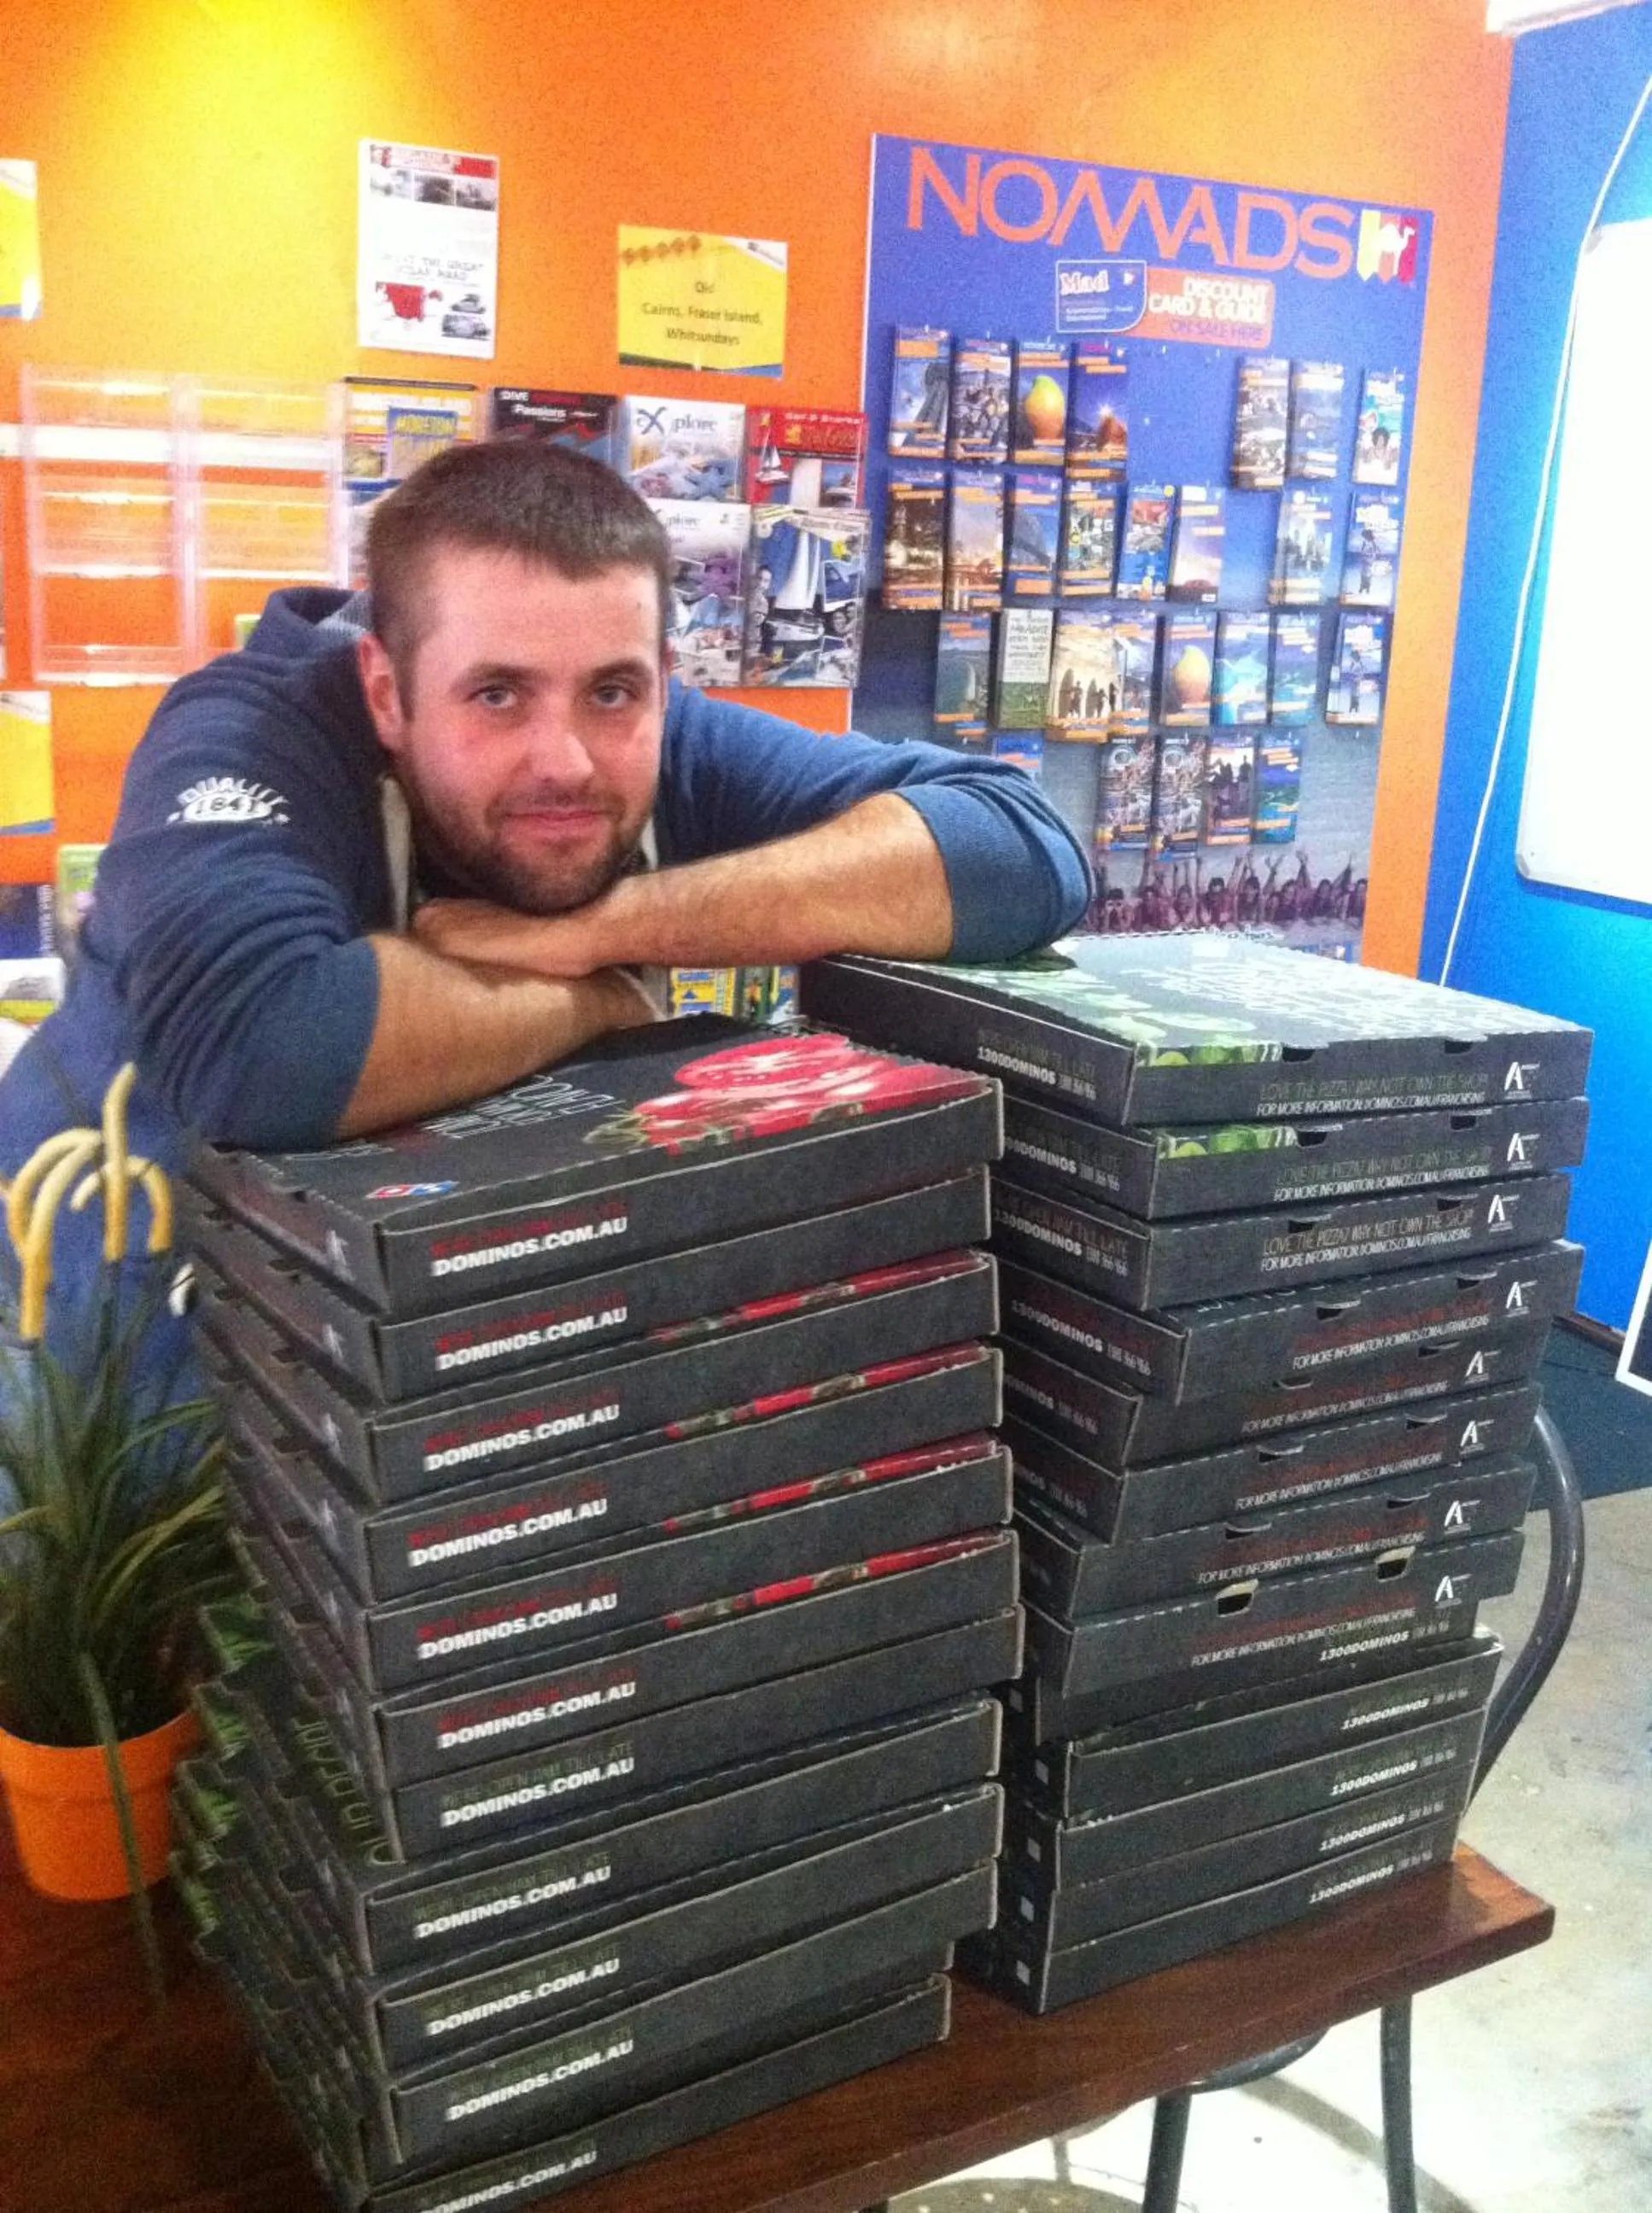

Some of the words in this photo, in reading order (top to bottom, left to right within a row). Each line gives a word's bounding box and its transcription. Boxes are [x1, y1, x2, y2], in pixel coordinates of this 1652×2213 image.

[907, 146, 1353, 279] NOMADS
[1059, 270, 1109, 295] Mad
[1148, 294, 1194, 316] CARD
[1199, 299, 1214, 318] &
[1215, 301, 1268, 324] GUIDE
[1182, 277, 1269, 304] DISCOUNT
[1196, 321, 1223, 336] SALE
[1229, 324, 1264, 341] HERE
[195, 795, 261, 815] 1841
[1257, 1101, 1276, 1117] FOR
[1277, 1101, 1303, 1115] MORE
[430, 1216, 628, 1276] DOMINOS.COM.AU
[1260, 1257, 1278, 1272] FOR
[1279, 1253, 1305, 1270] MORE
[1263, 1236, 1295, 1257] LOVE
[1296, 1233, 1316, 1252] THE
[435, 1306, 628, 1370] DOMINOS.COM.AU
[423, 1404, 620, 1472] DOMINOS.COM.AU
[408, 1498, 608, 1568] DOMINOS.COM.AU
[417, 1592, 617, 1660] DOMINOS.COM.AU
[436, 1681, 636, 1749] DOMINOS.COM.AU
[440, 1756, 634, 1827] DOMINOS.COM.AU
[1330, 1760, 1418, 1796] 1300DOMINOS
[413, 1865, 611, 1940] DOMINOS.COM.AU
[425, 1957, 620, 2036] DOMINOS.COM.AU
[444, 2039, 633, 2122] DOMINOS.COM.AU
[420, 2150, 597, 2213] OMINOS.COM.AU
